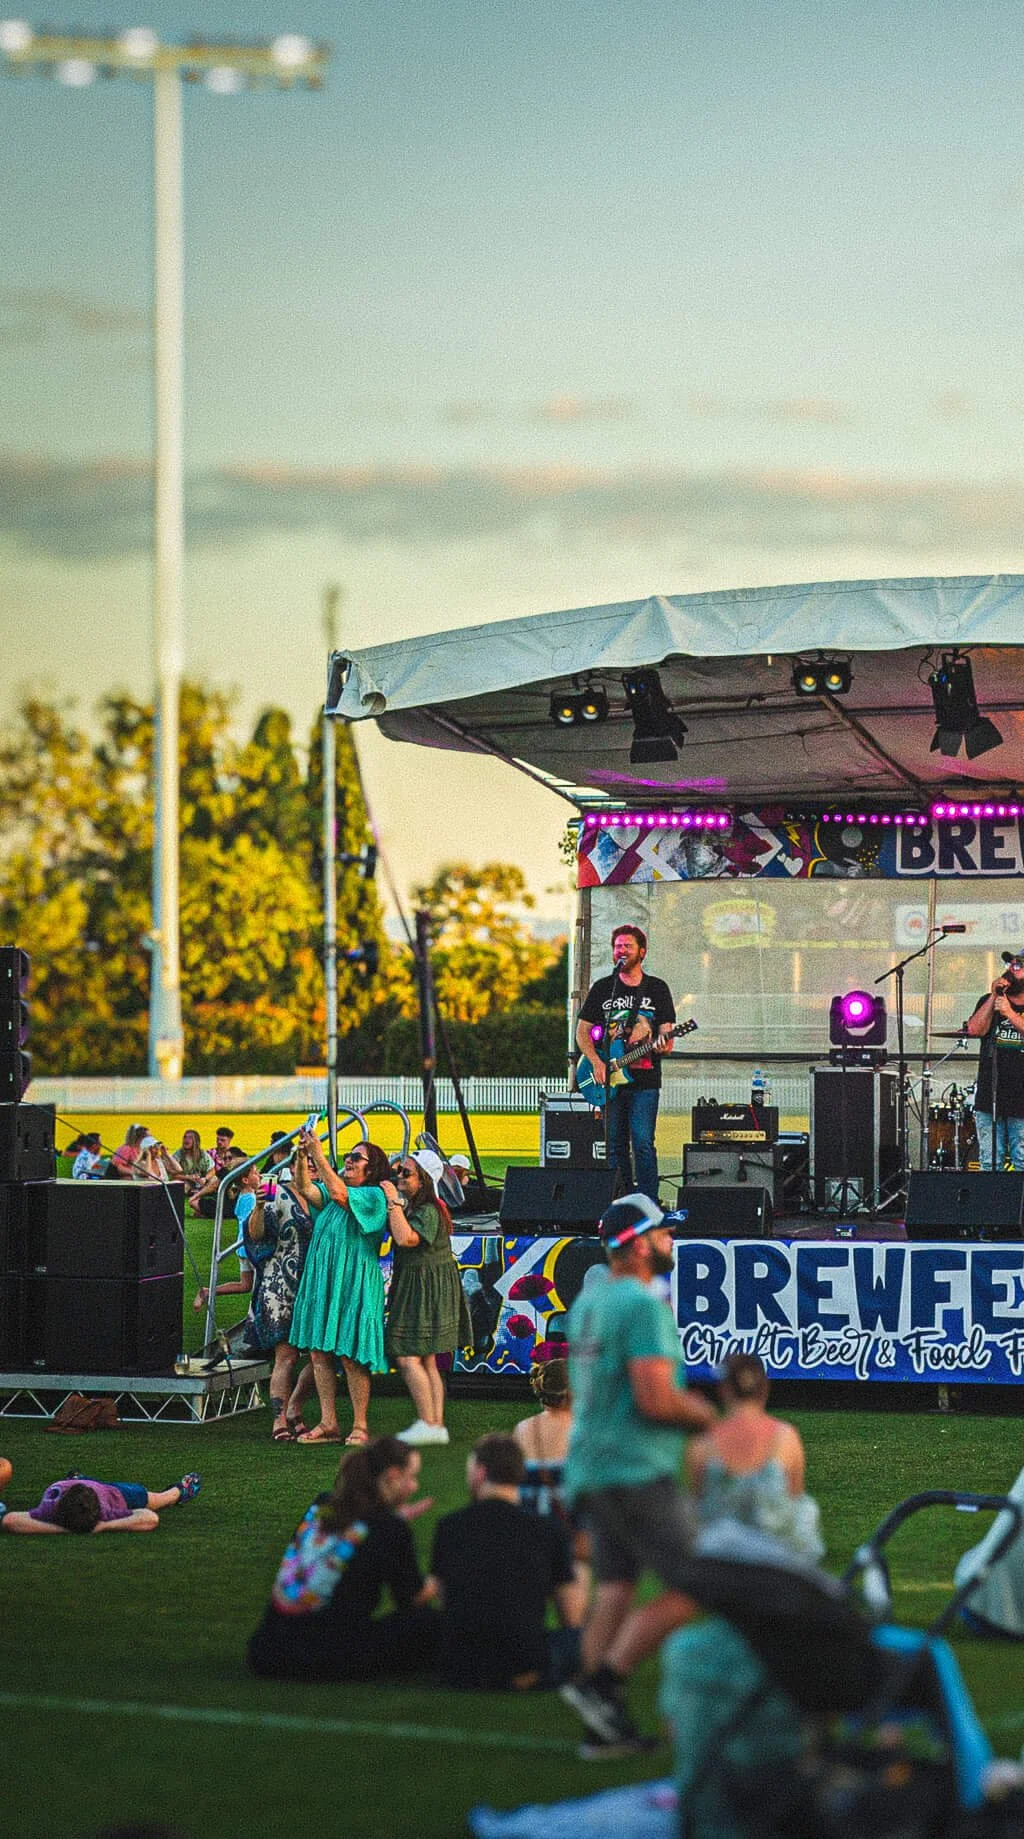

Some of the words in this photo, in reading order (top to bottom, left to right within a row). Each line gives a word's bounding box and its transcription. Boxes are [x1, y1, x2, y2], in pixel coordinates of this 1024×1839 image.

[1000, 912, 1020, 933] 13
[682, 1322, 794, 1368] Craft
[801, 1324, 872, 1377] Beer
[878, 1338, 892, 1365] &
[902, 1327, 990, 1372] Food
